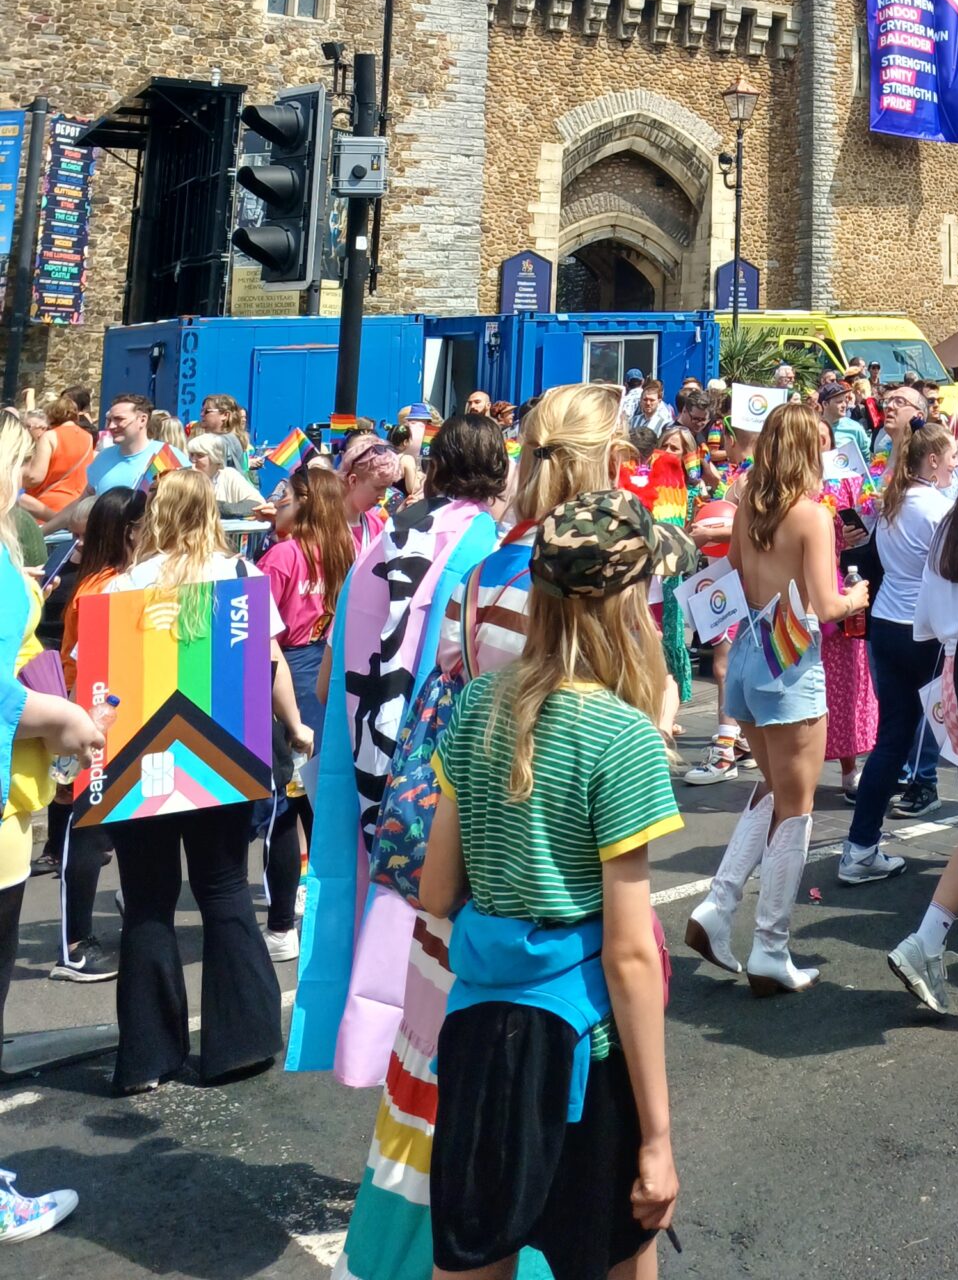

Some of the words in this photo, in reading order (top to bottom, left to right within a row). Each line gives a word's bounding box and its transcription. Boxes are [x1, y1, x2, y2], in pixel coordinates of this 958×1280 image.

[879, 6, 918, 20] UNDOD
[880, 19, 925, 36] CRYFDER
[880, 32, 931, 51] BALCHDER
[881, 54, 931, 73] STRENGTH
[882, 68, 913, 82] UNITY
[882, 81, 931, 101] STRENGTH
[883, 96, 912, 111] PRIDE
[55, 123, 80, 137] DEPOT
[231, 594, 249, 648] VISA
